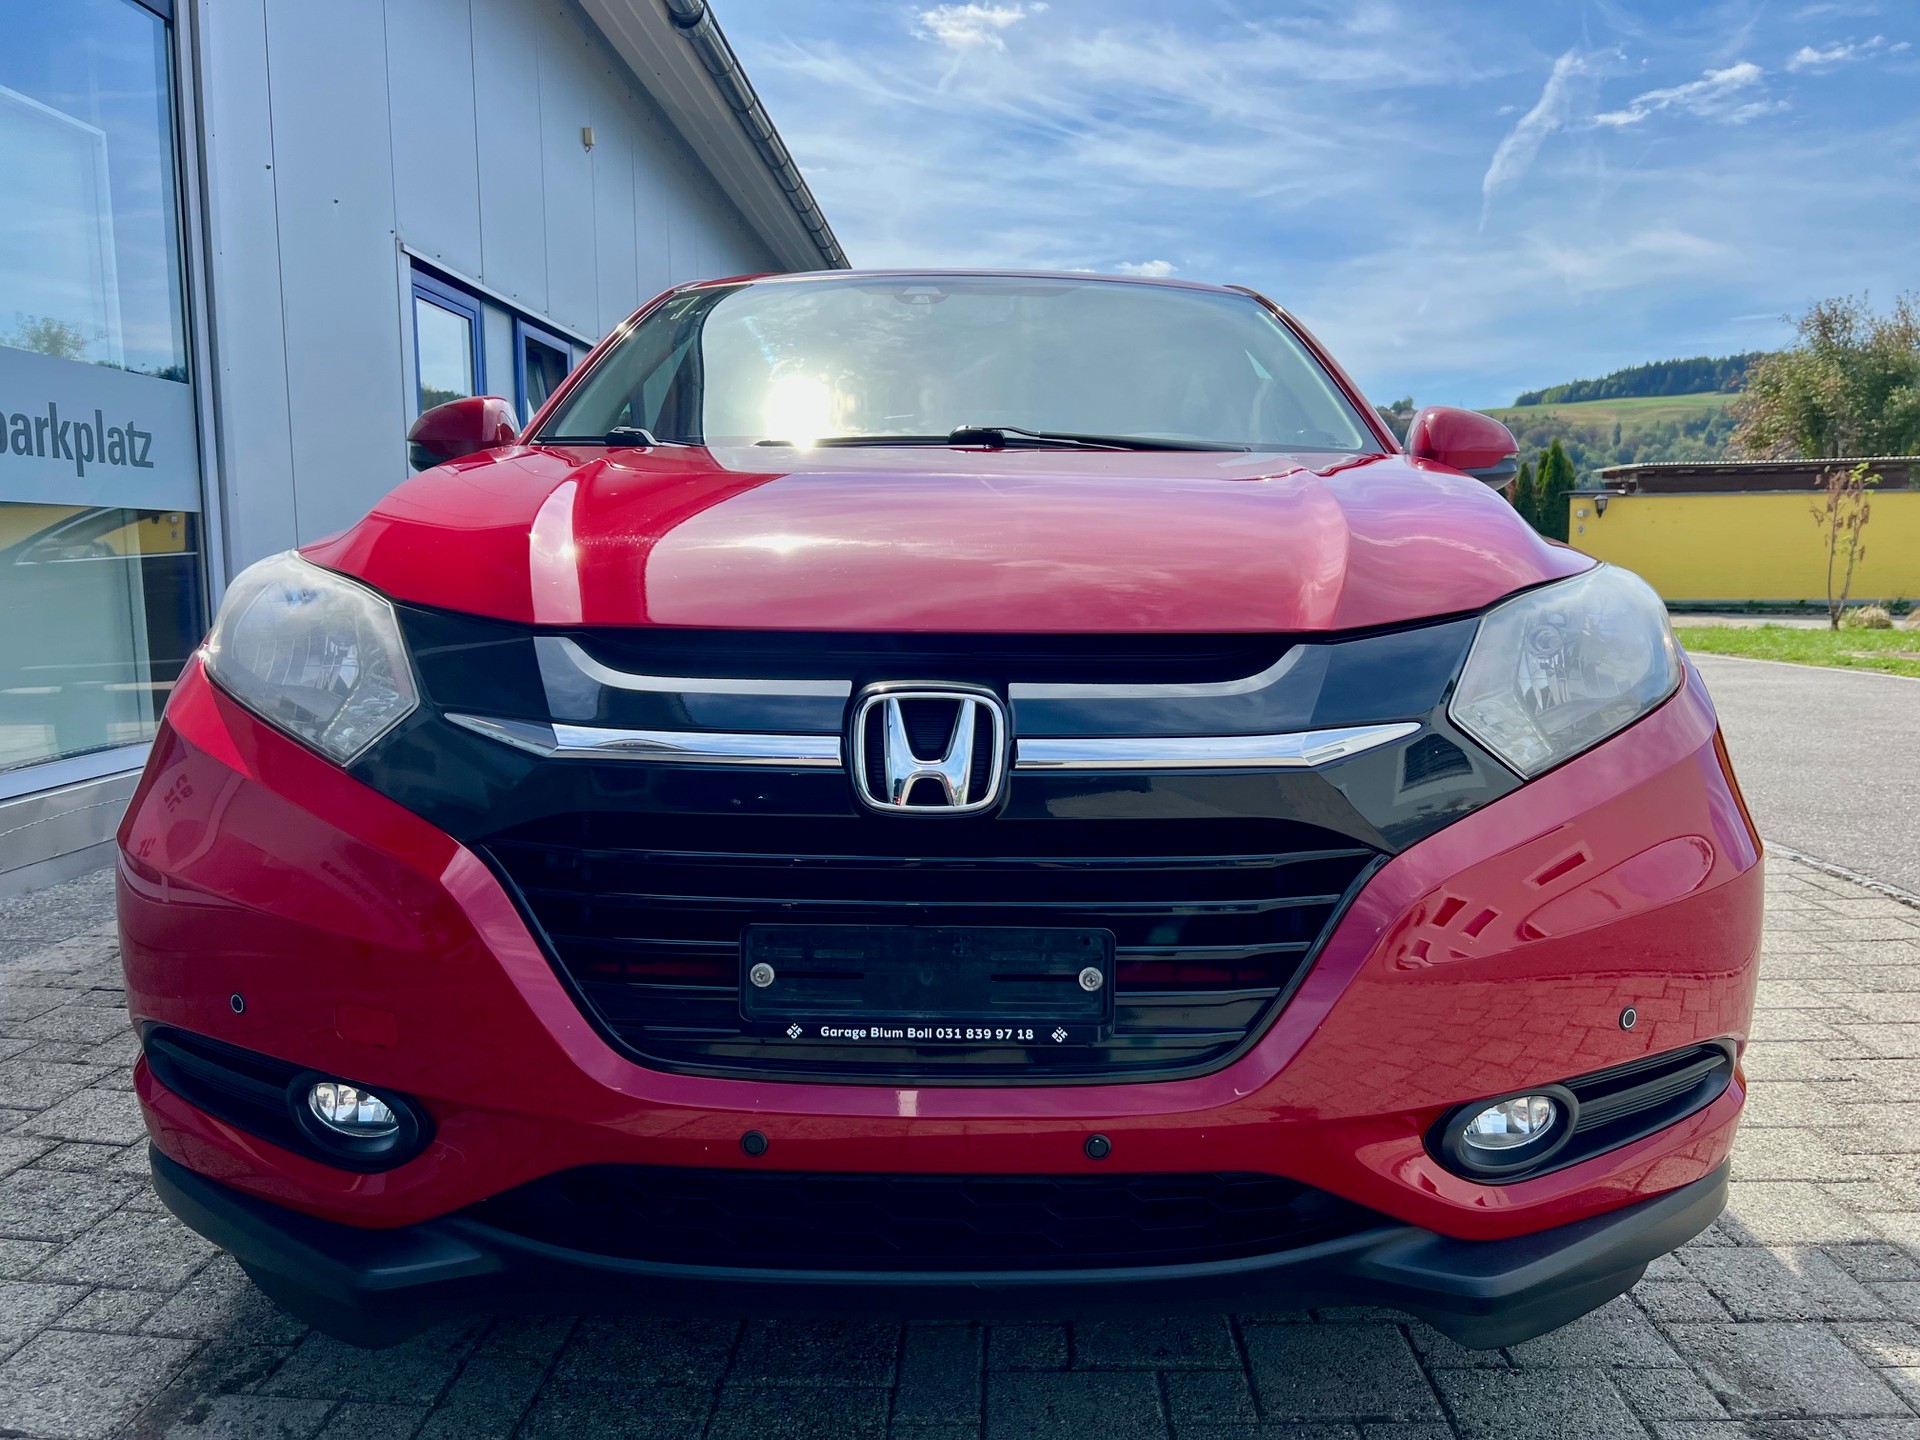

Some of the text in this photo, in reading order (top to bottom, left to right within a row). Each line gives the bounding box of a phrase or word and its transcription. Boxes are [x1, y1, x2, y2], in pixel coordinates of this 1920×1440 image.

[819, 1026, 1035, 1040] Garage Blum Boll 031 839 97 18
